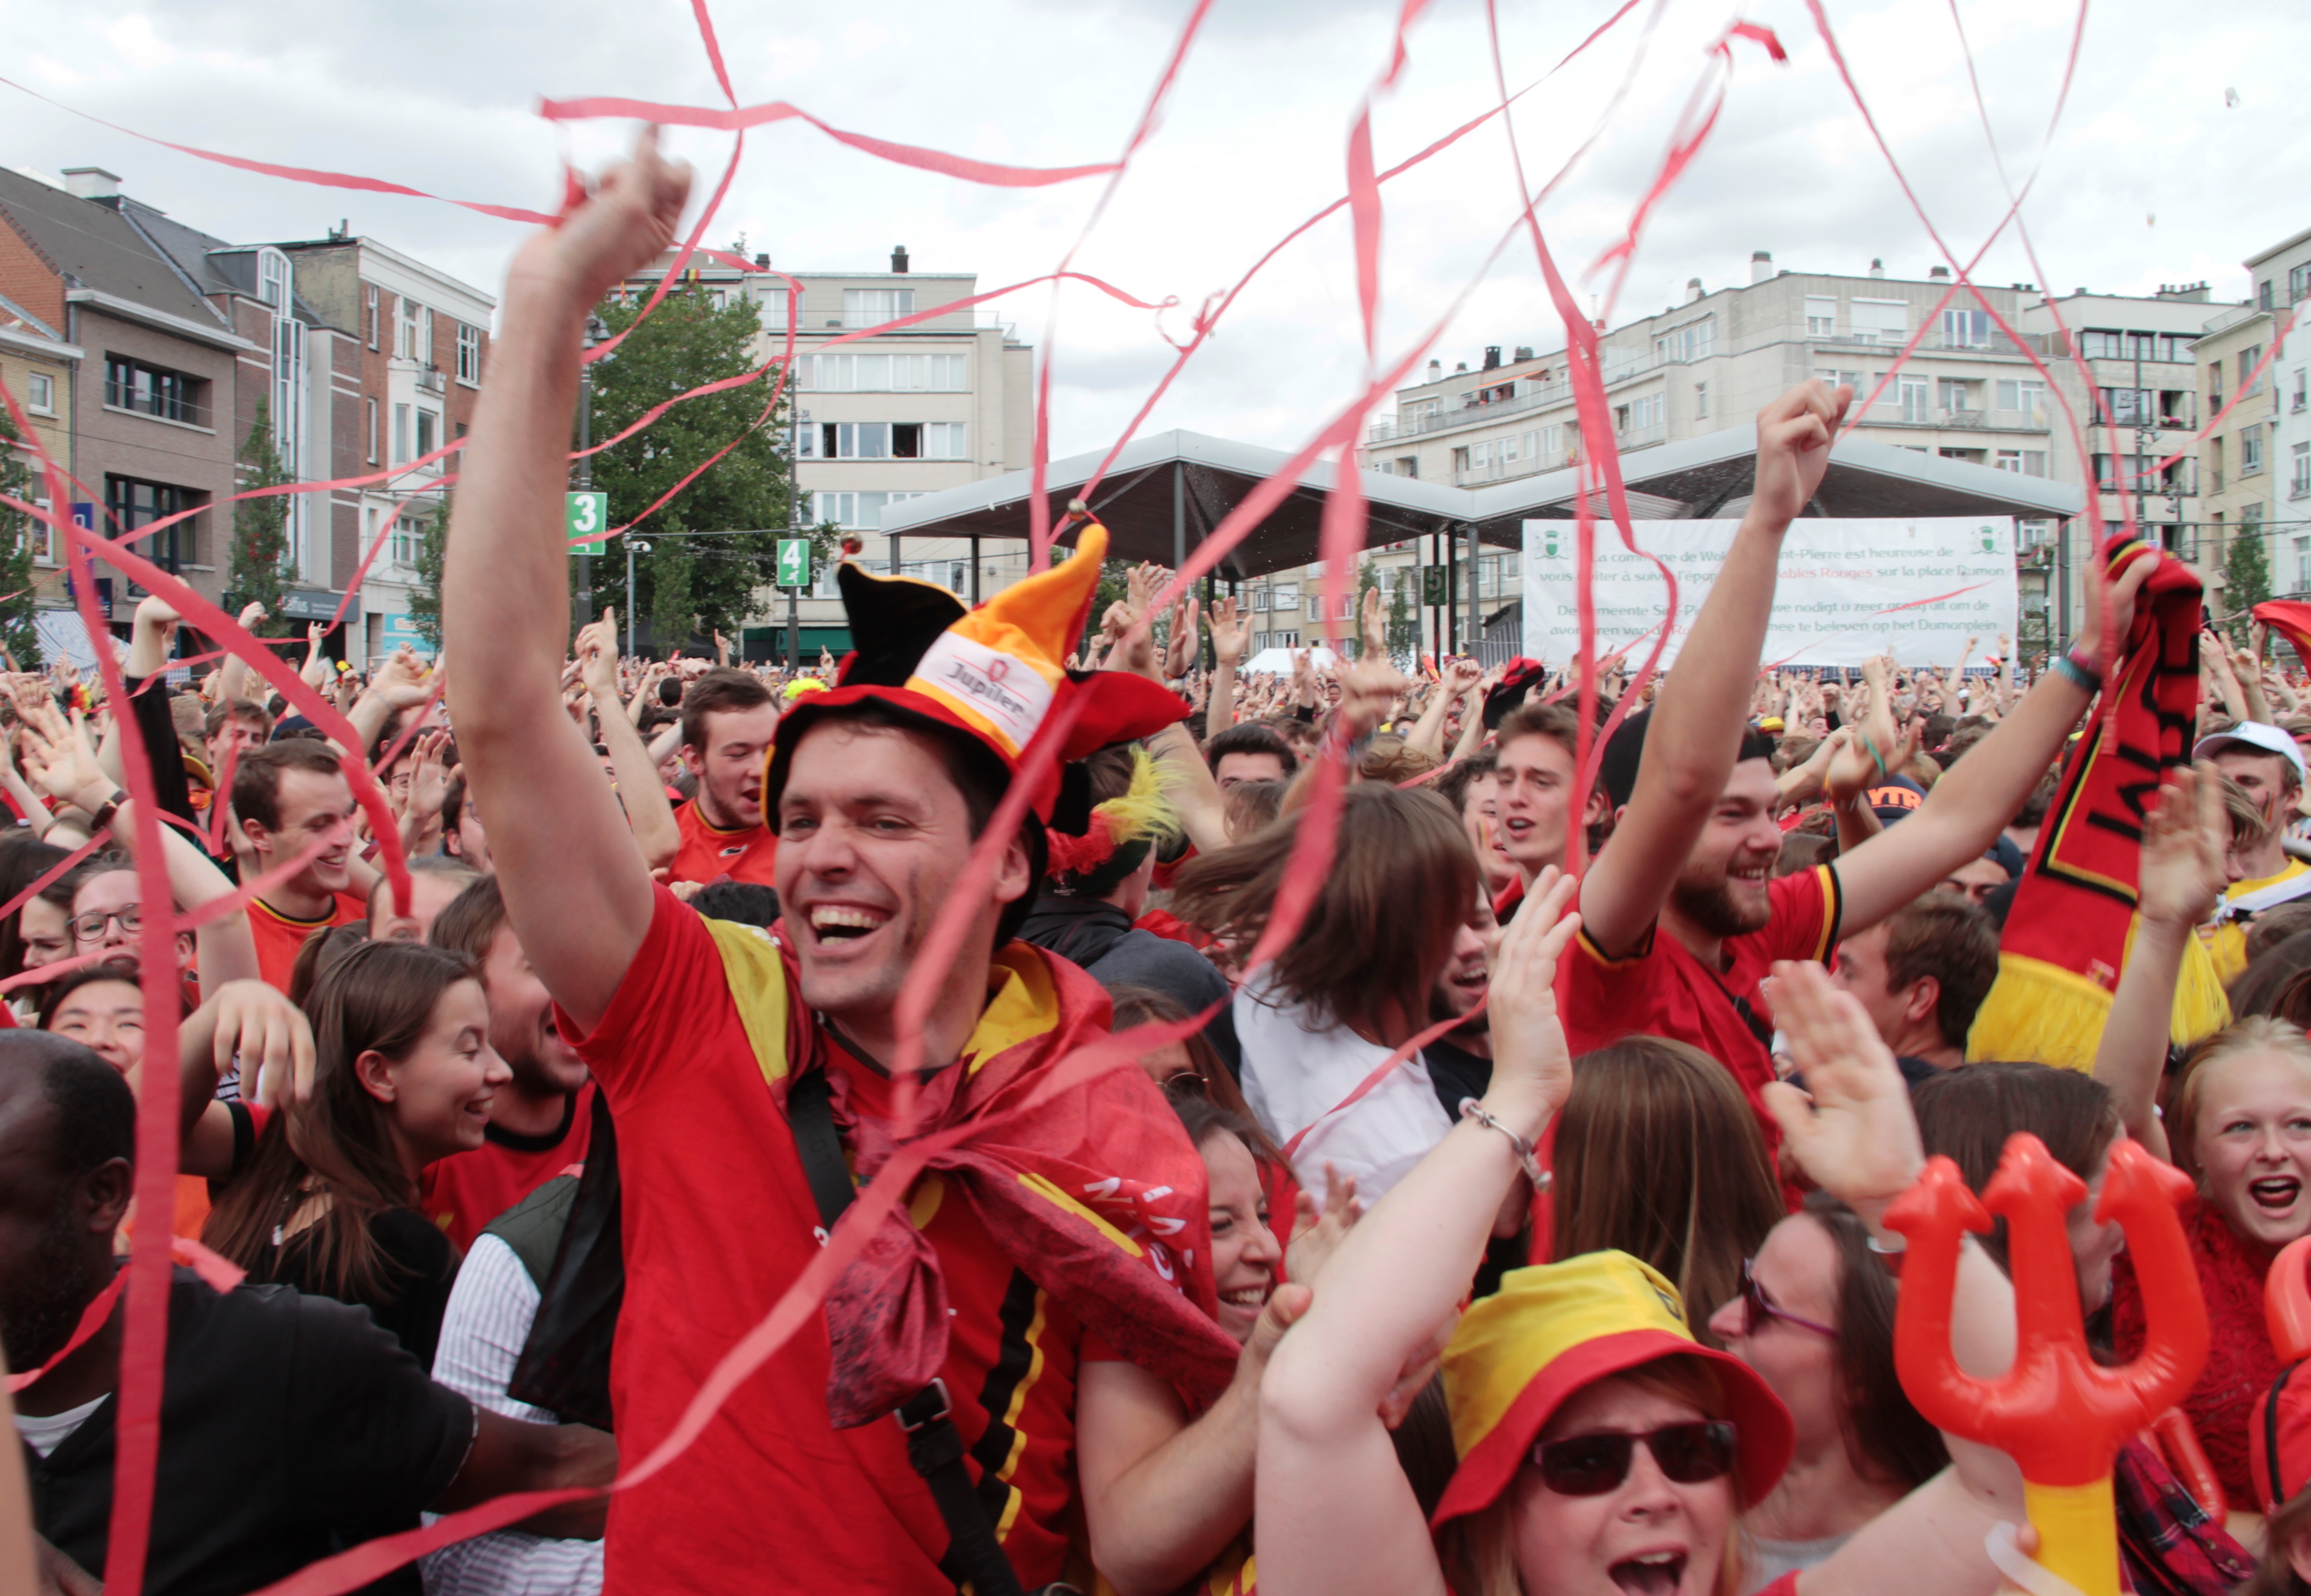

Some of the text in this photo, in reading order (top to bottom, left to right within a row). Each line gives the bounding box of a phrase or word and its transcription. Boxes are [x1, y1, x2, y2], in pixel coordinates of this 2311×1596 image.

[573, 494, 597, 532] 3
[782, 540, 801, 569] 4
[1611, 553, 1676, 562] commne
[1680, 551, 1697, 562] de
[1845, 549, 1866, 559] est
[1869, 548, 1934, 557] heureuse
[1937, 546, 1954, 556] de
[1428, 566, 1442, 591] 5
[1540, 573, 1573, 581] vous
[1577, 570, 1618, 581] iviter
[1621, 571, 1631, 581] à
[1678, 570, 1720, 584] l'épop
[1777, 568, 1817, 578] iables
[1819, 567, 1872, 580] Rouges
[1877, 567, 1898, 576] sur
[1901, 565, 1915, 576] la
[1919, 565, 1954, 578] place
[1957, 565, 2005, 576] Dumon
[1557, 605, 1577, 616] De
[1595, 605, 1649, 616] meente
[1795, 602, 1838, 614] nodigt
[1854, 603, 1882, 611] zeer
[1929, 600, 1946, 610] uit
[1949, 602, 1970, 610] om
[1973, 599, 1990, 610] de
[1550, 626, 1619, 635] avoren
[1623, 626, 1649, 635] van
[1798, 622, 1811, 632] te
[1815, 621, 1869, 632] beleven
[1872, 622, 1890, 633] op
[1893, 620, 1917, 631] het
[1918, 619, 1997, 633] Dumonplein
[946, 662, 1024, 714] Jupiler
